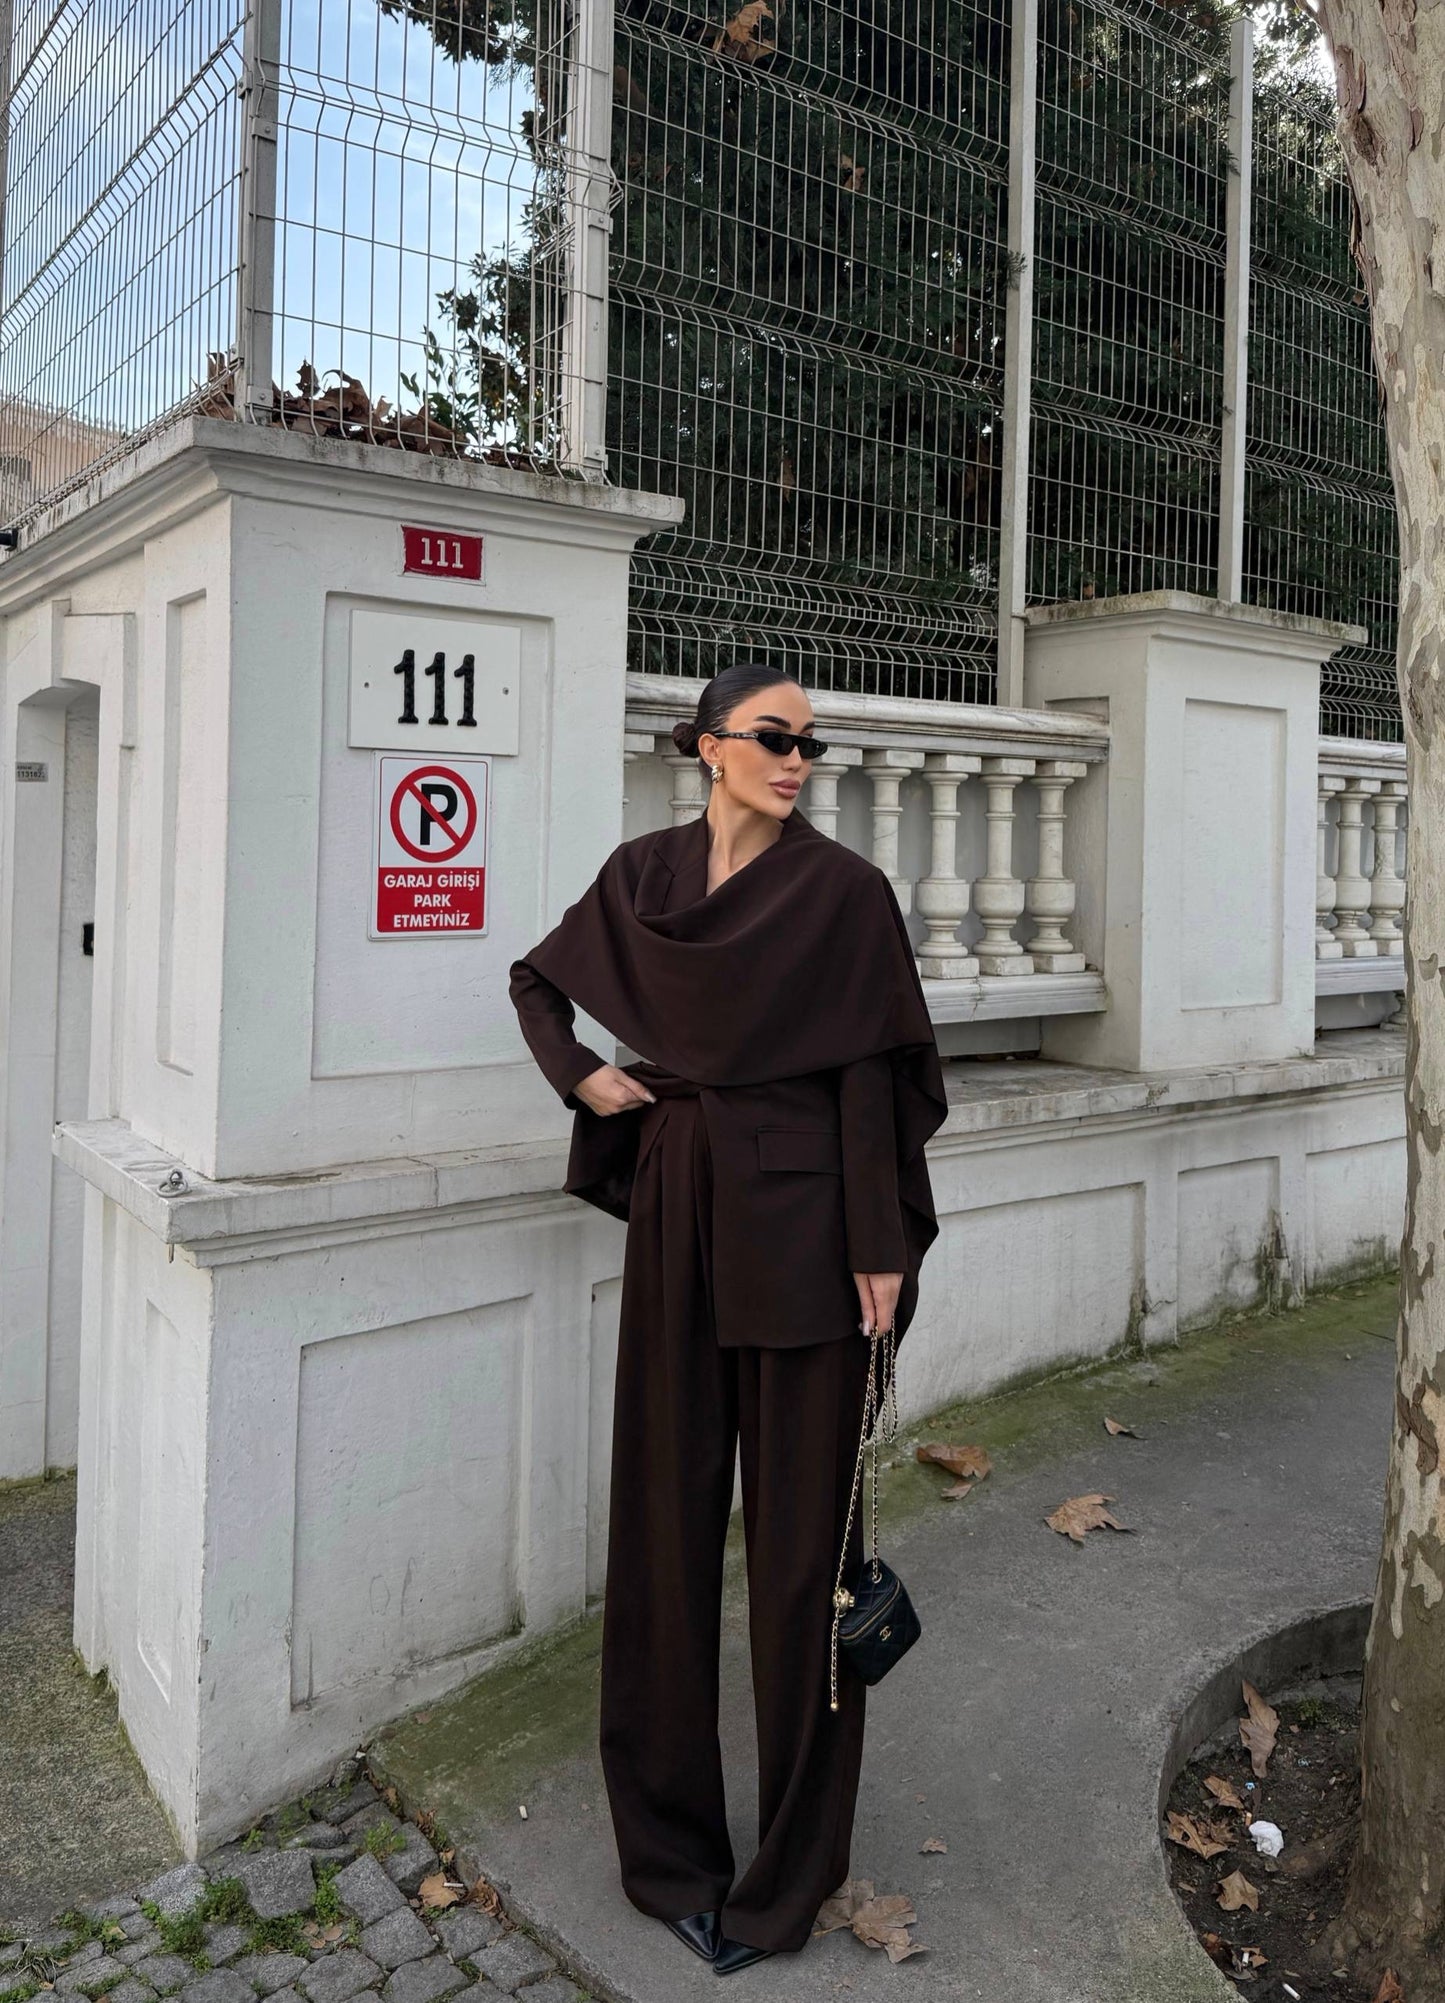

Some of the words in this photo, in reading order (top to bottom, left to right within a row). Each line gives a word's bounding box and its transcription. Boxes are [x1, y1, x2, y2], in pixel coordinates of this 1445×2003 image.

[421, 537, 464, 569] 111
[394, 649, 477, 726] 111
[420, 784, 458, 846] P
[384, 874, 433, 888] GARAJ
[437, 870, 480, 891] GİRİŞİ
[414, 894, 452, 907] PARK
[393, 909, 471, 928] ETMEYİNİZ
